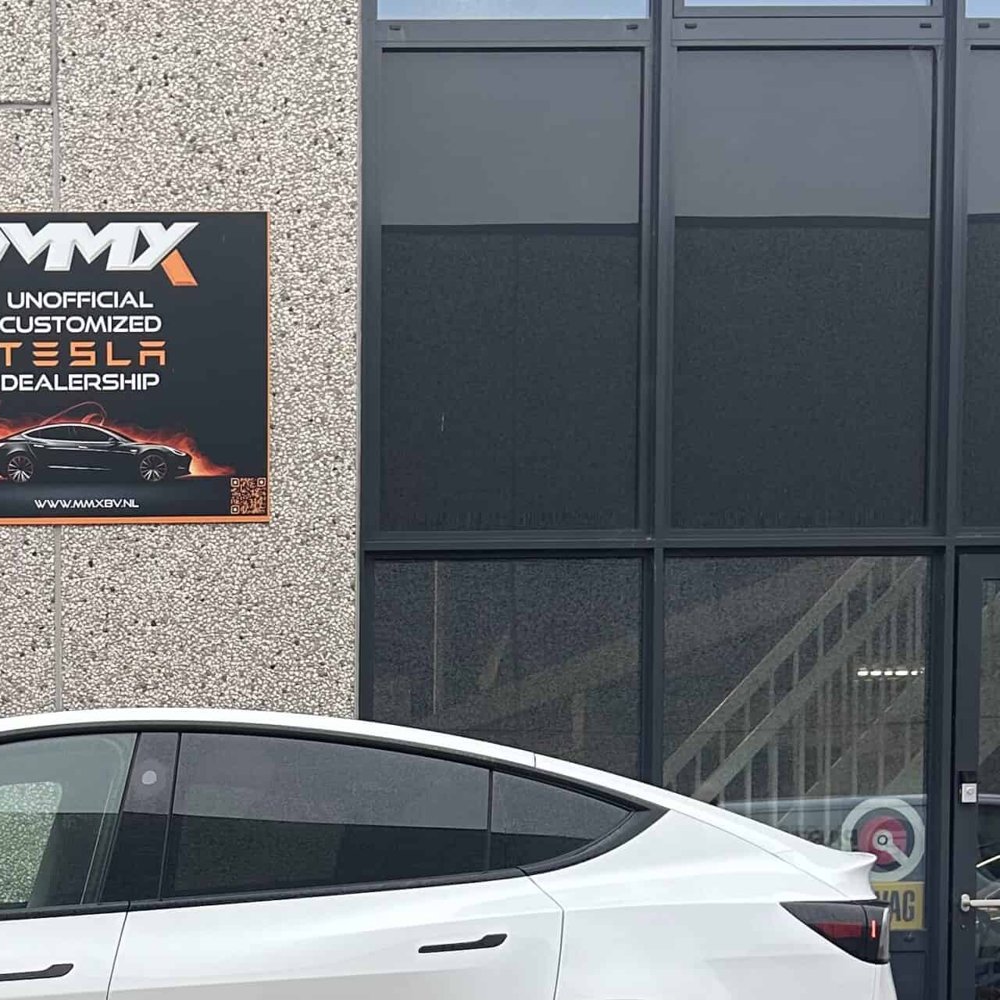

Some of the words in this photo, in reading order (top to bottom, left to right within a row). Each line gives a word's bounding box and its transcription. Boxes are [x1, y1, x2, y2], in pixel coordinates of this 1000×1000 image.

[7, 291, 154, 309] UNOFFICIAL
[0, 315, 162, 334] CUSTOMIZED
[0, 373, 160, 391] DEALERSHIP
[34, 499, 139, 509] WWW.MMXBV.NL
